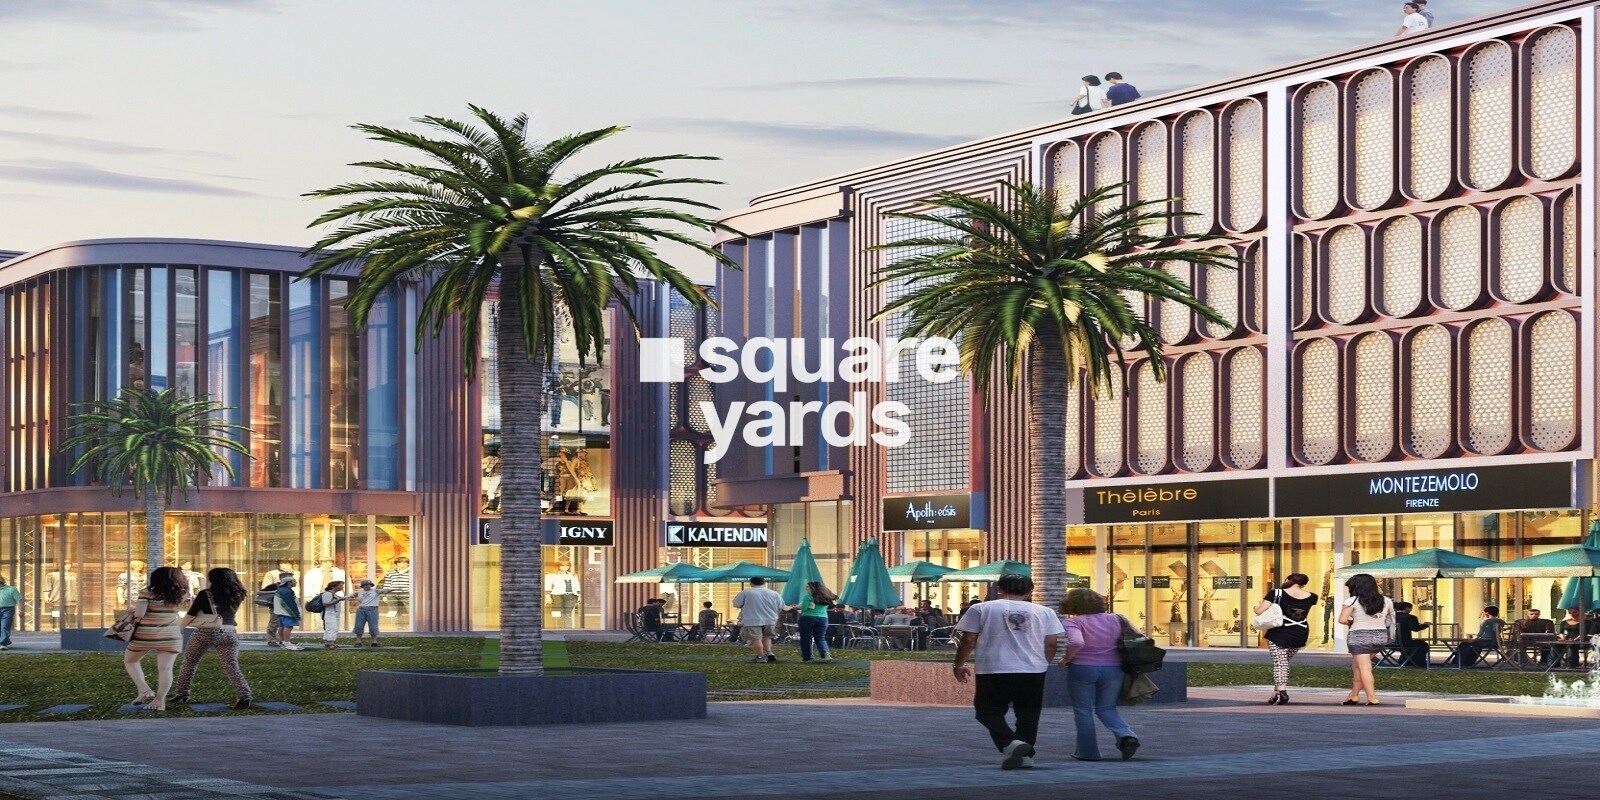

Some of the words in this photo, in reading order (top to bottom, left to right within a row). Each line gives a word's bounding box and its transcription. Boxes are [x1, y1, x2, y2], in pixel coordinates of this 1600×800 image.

[1369, 472, 1479, 495] MONTEZEMOLO
[1405, 498, 1439, 508] FIRENZE
[1132, 509, 1161, 517] Paris
[688, 527, 767, 542] KALTENDIN
